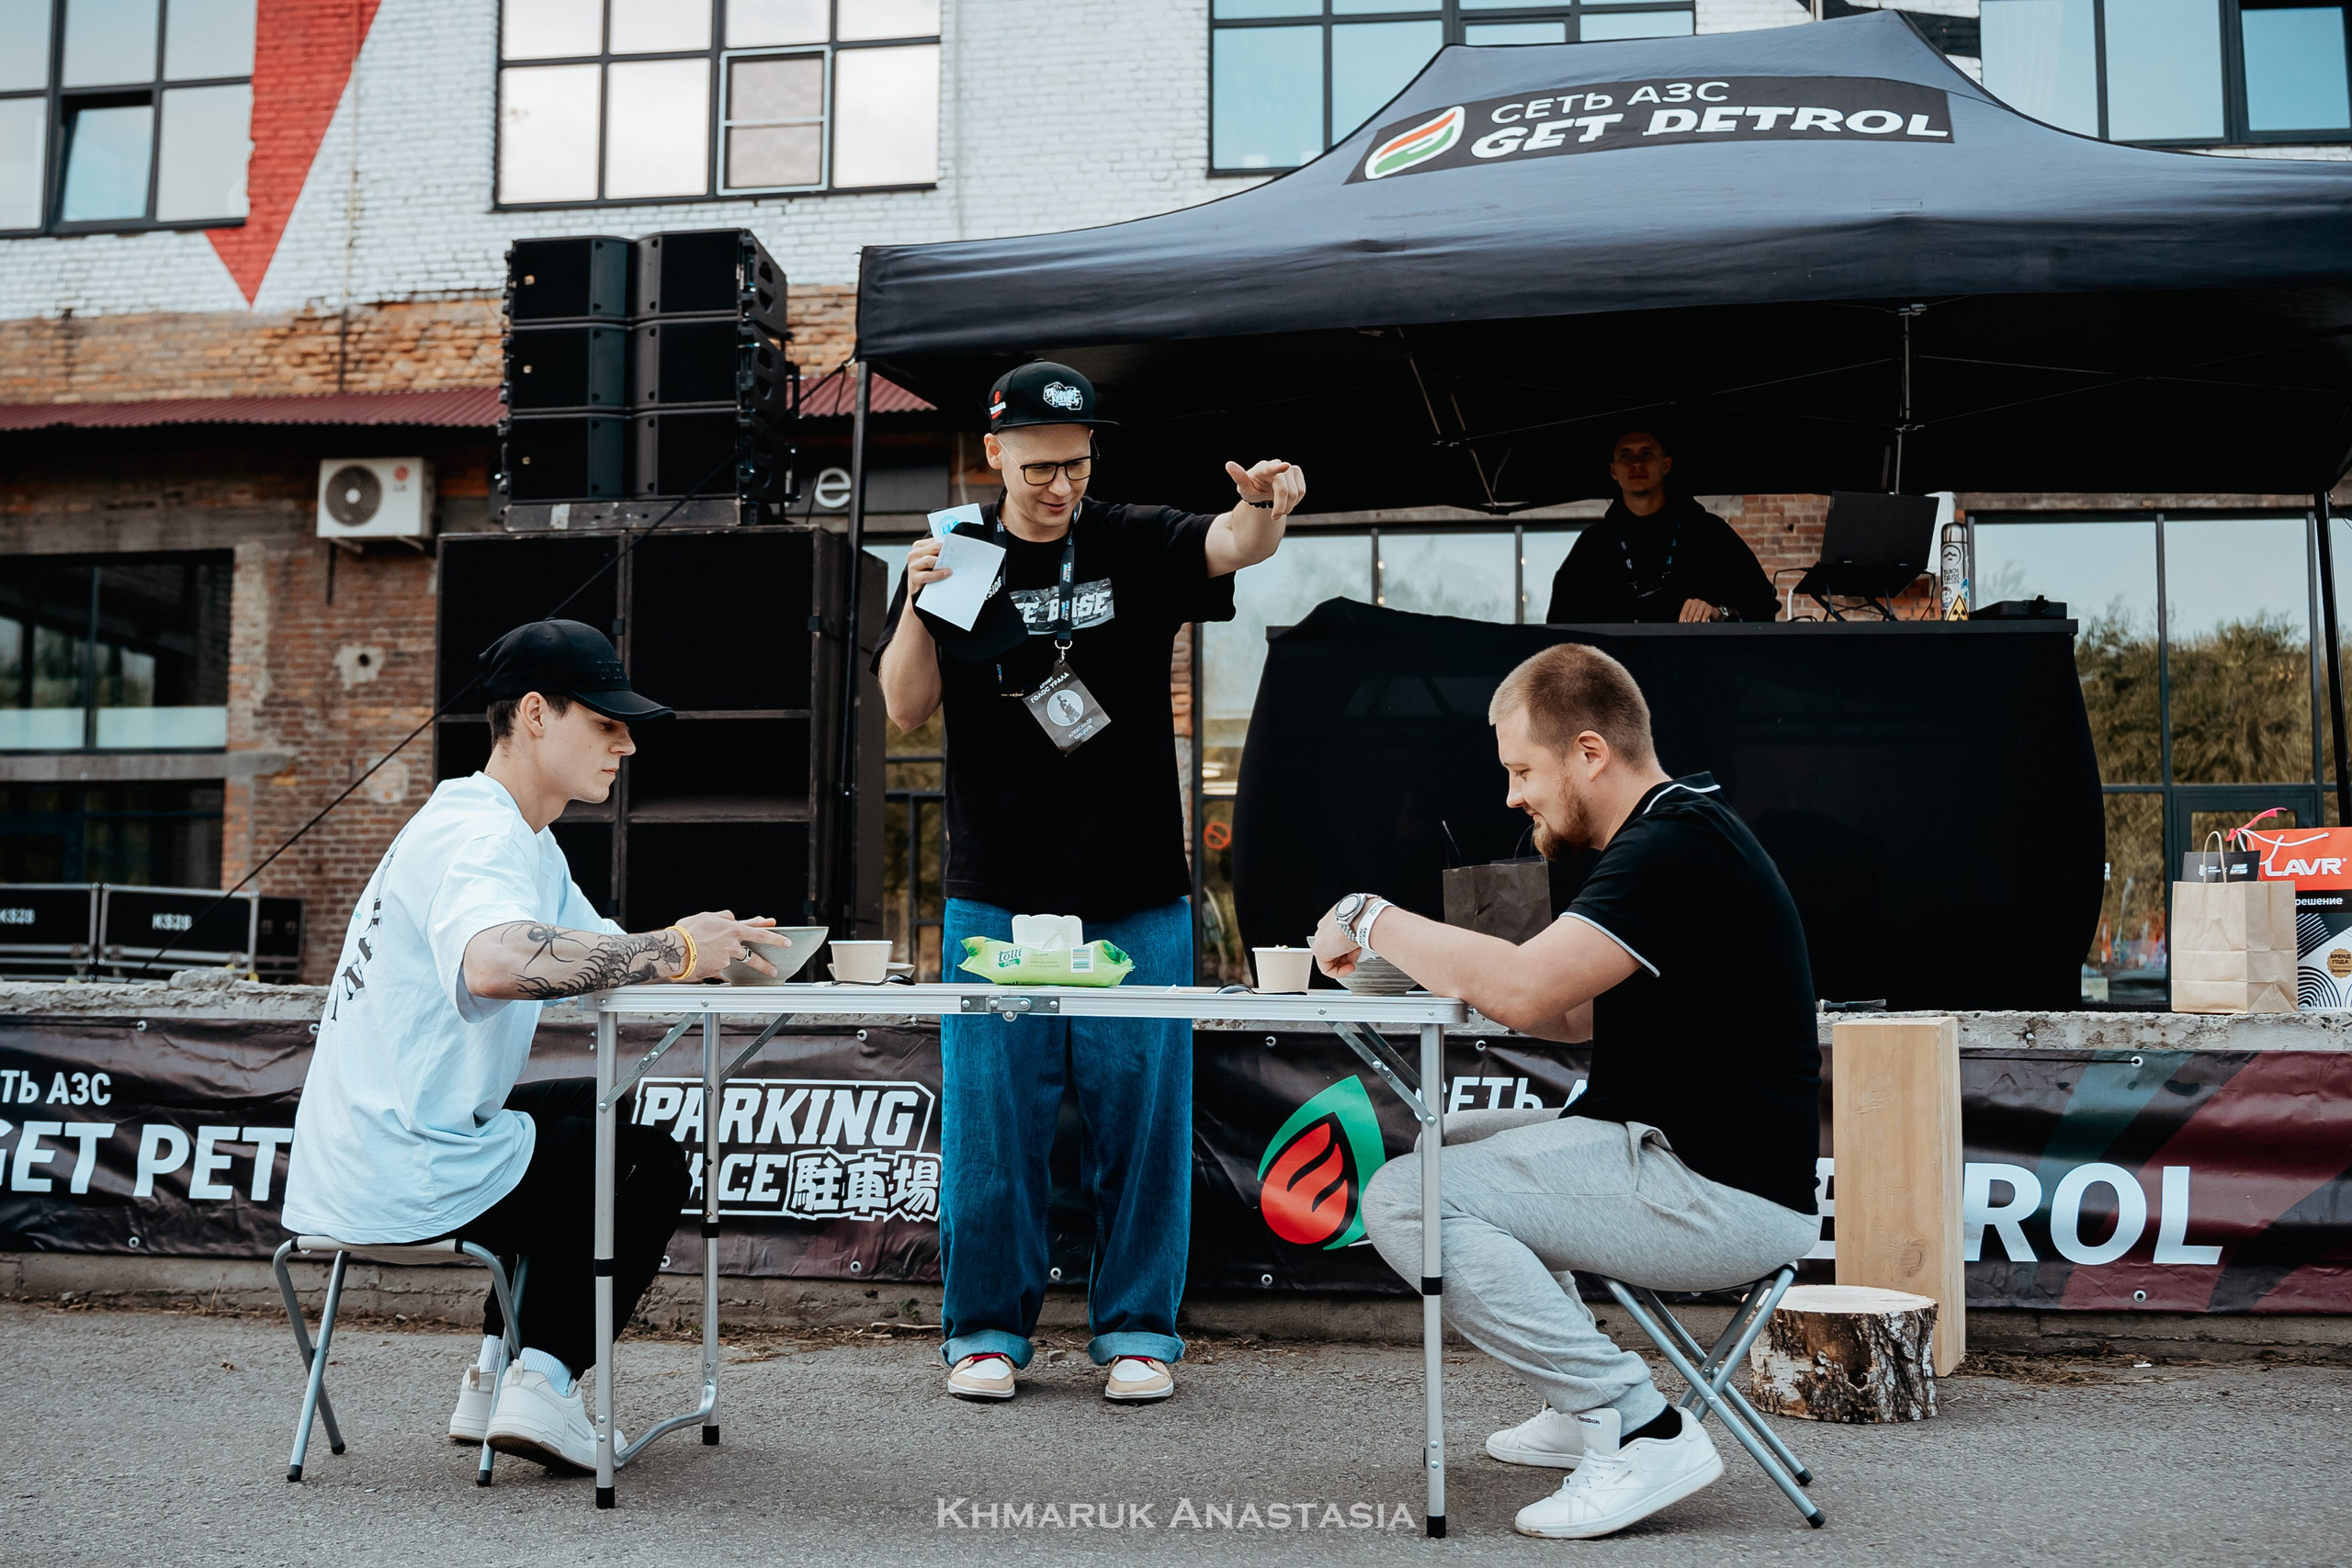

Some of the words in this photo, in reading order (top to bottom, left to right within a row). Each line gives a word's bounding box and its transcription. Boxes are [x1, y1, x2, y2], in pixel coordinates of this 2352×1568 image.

[1490, 92, 1613, 124] СЕТЬ
[1626, 81, 1730, 106] АЗС
[1470, 113, 1624, 158] GET
[1049, 671, 1070, 689] УРАЛА
[2265, 858, 2343, 876] LAVR
[0, 1069, 40, 1103] ТЬ
[46, 1072, 111, 1106] АЗС
[641, 1087, 920, 1145] PARKING
[133, 1123, 294, 1201] PET
[792, 1156, 939, 1213] 駐車場
[1577, 1415, 1600, 1425] Reebok
